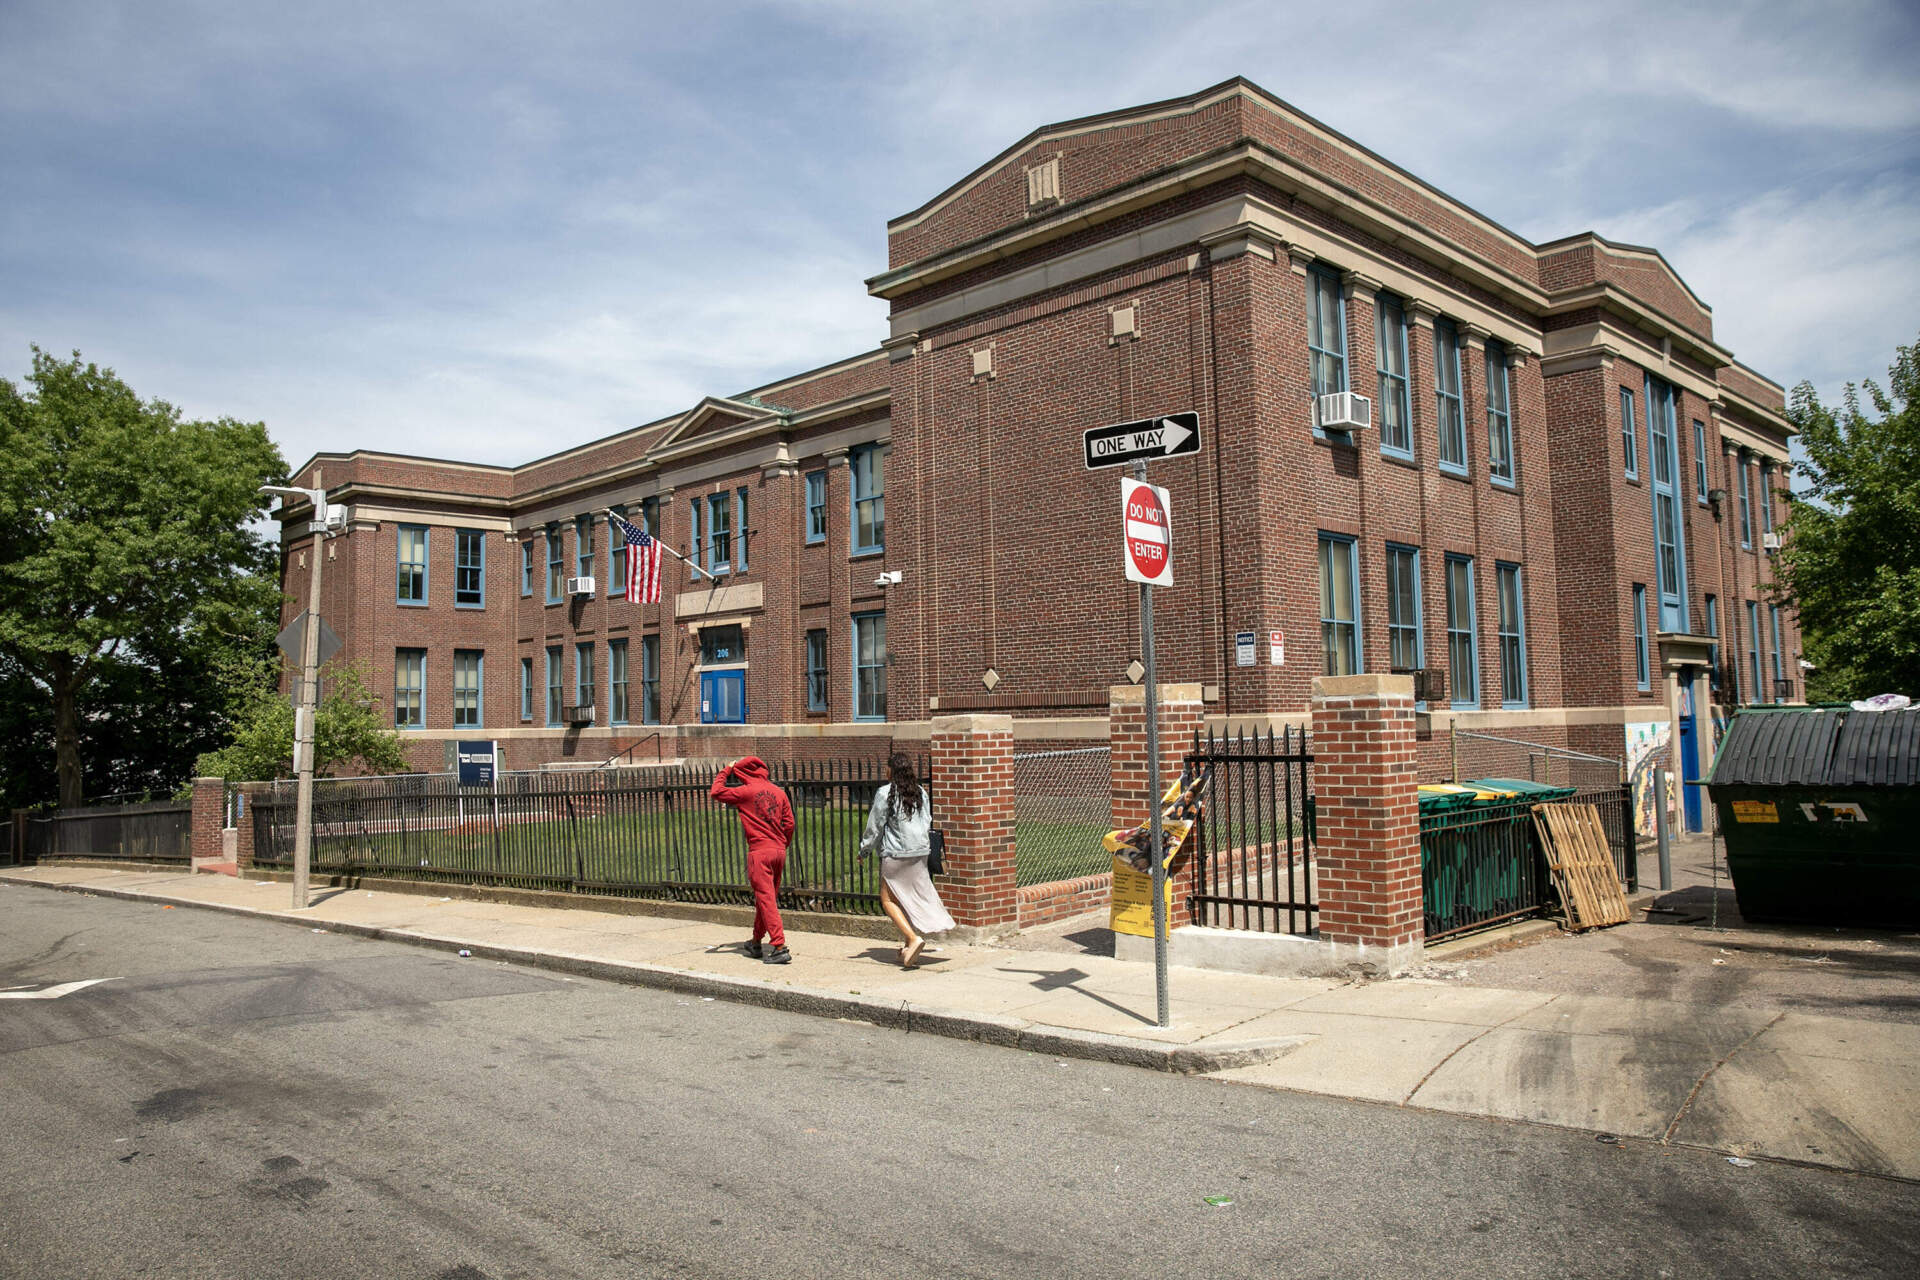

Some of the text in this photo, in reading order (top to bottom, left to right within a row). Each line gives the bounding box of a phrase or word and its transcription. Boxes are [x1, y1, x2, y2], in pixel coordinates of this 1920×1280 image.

[1096, 430, 1165, 455] ONE WAY
[1130, 503, 1163, 523] DO NOT
[1135, 542, 1163, 561] ENTER
